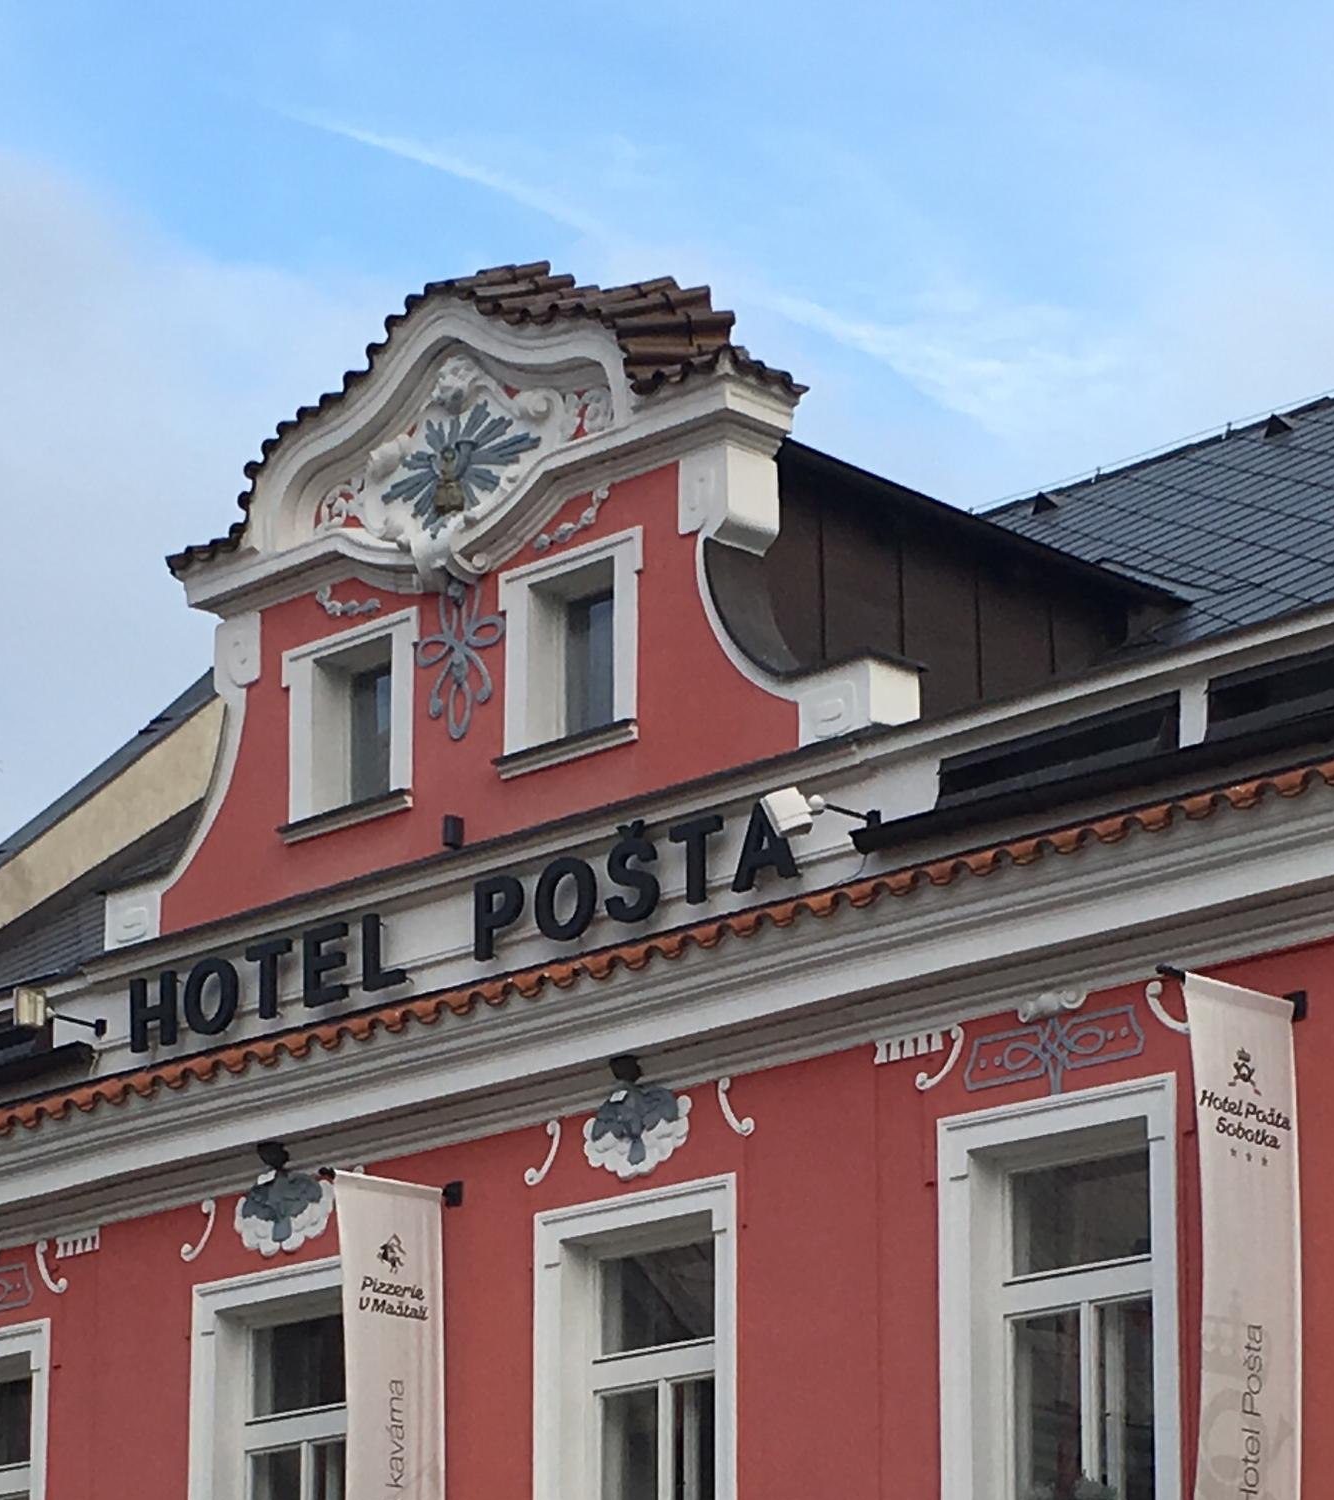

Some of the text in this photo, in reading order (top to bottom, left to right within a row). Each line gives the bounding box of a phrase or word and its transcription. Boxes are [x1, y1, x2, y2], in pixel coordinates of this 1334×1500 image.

[129, 804, 802, 1054] HOTEL POŠTA
[1199, 1089, 1291, 1131] Hotel Pošta
[1216, 1116, 1281, 1149] Sobotka
[361, 1275, 425, 1301] Pizzerie
[1240, 1323, 1263, 1419] Pošta
